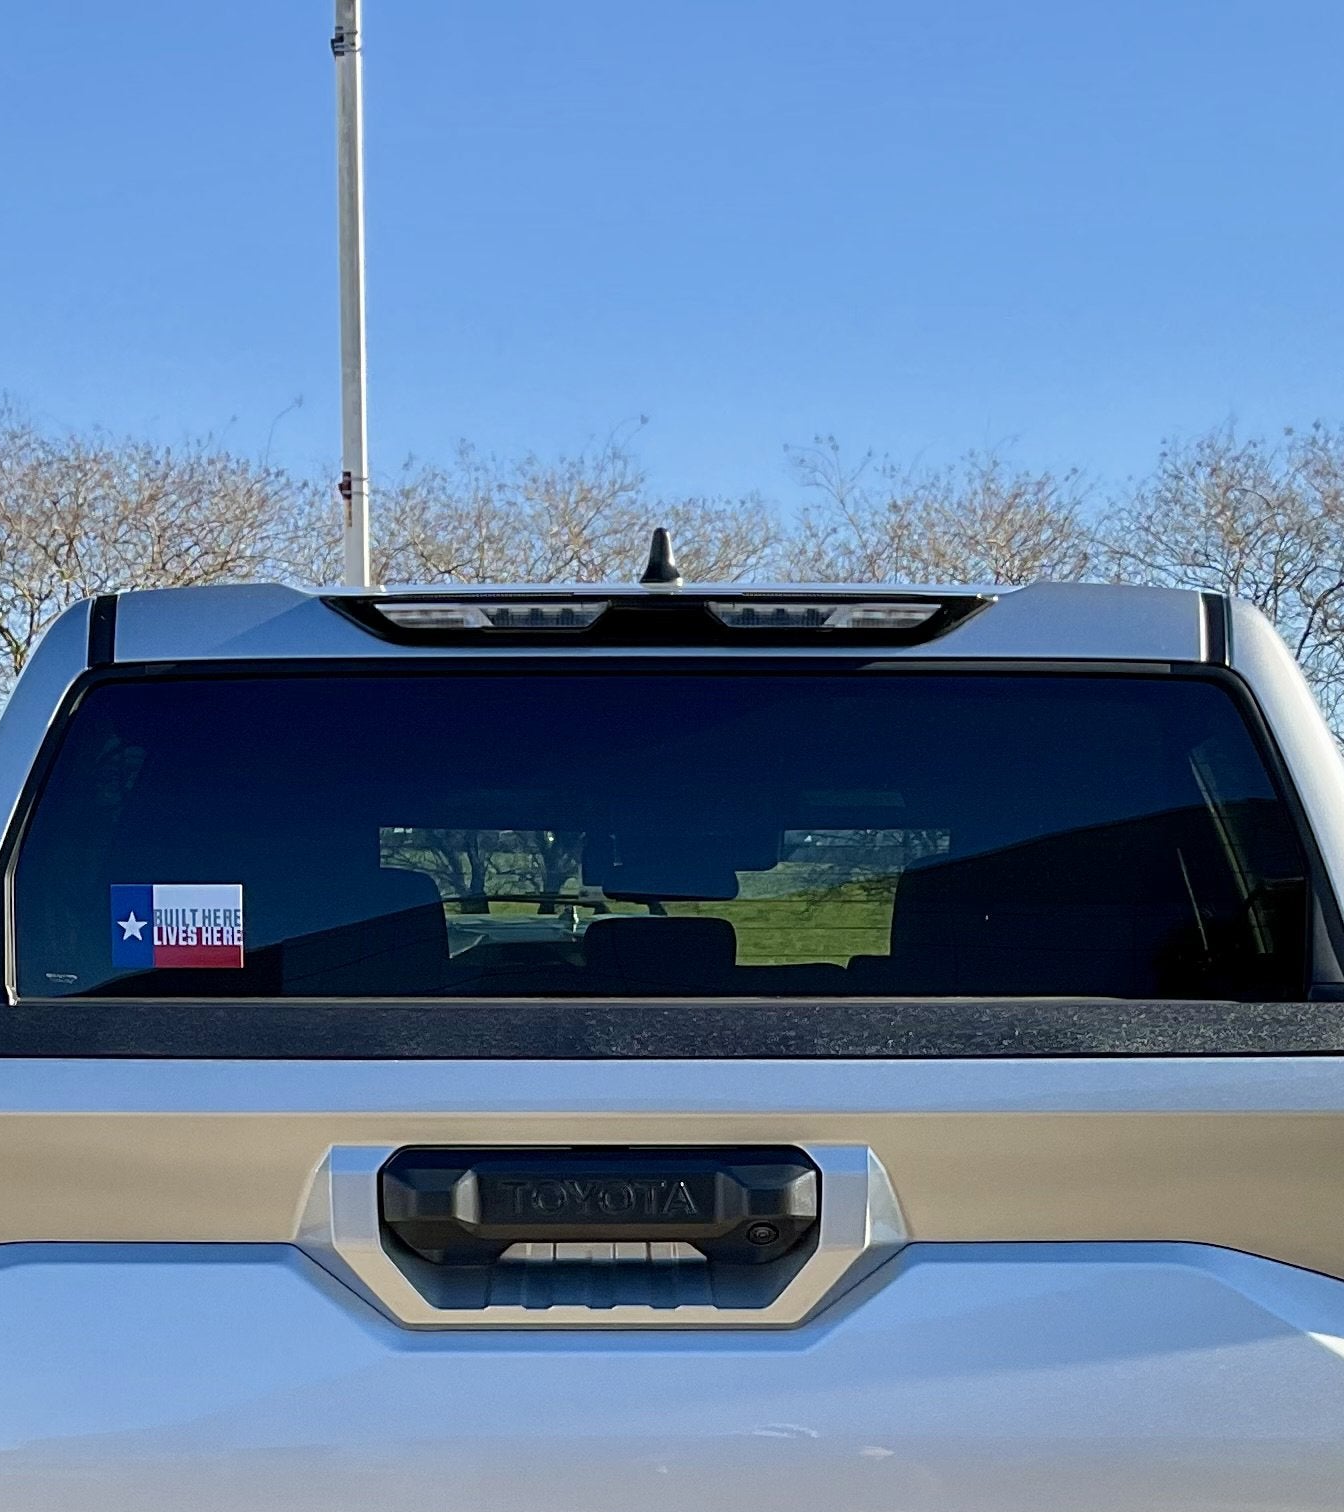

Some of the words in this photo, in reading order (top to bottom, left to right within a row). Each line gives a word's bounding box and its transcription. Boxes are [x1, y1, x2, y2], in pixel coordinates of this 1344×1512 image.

[153, 908, 198, 928] BUILT
[201, 908, 242, 928] HERE
[153, 926, 198, 946] LIVES
[201, 926, 243, 946] HERE
[500, 1178, 699, 1218] TOYOTA
